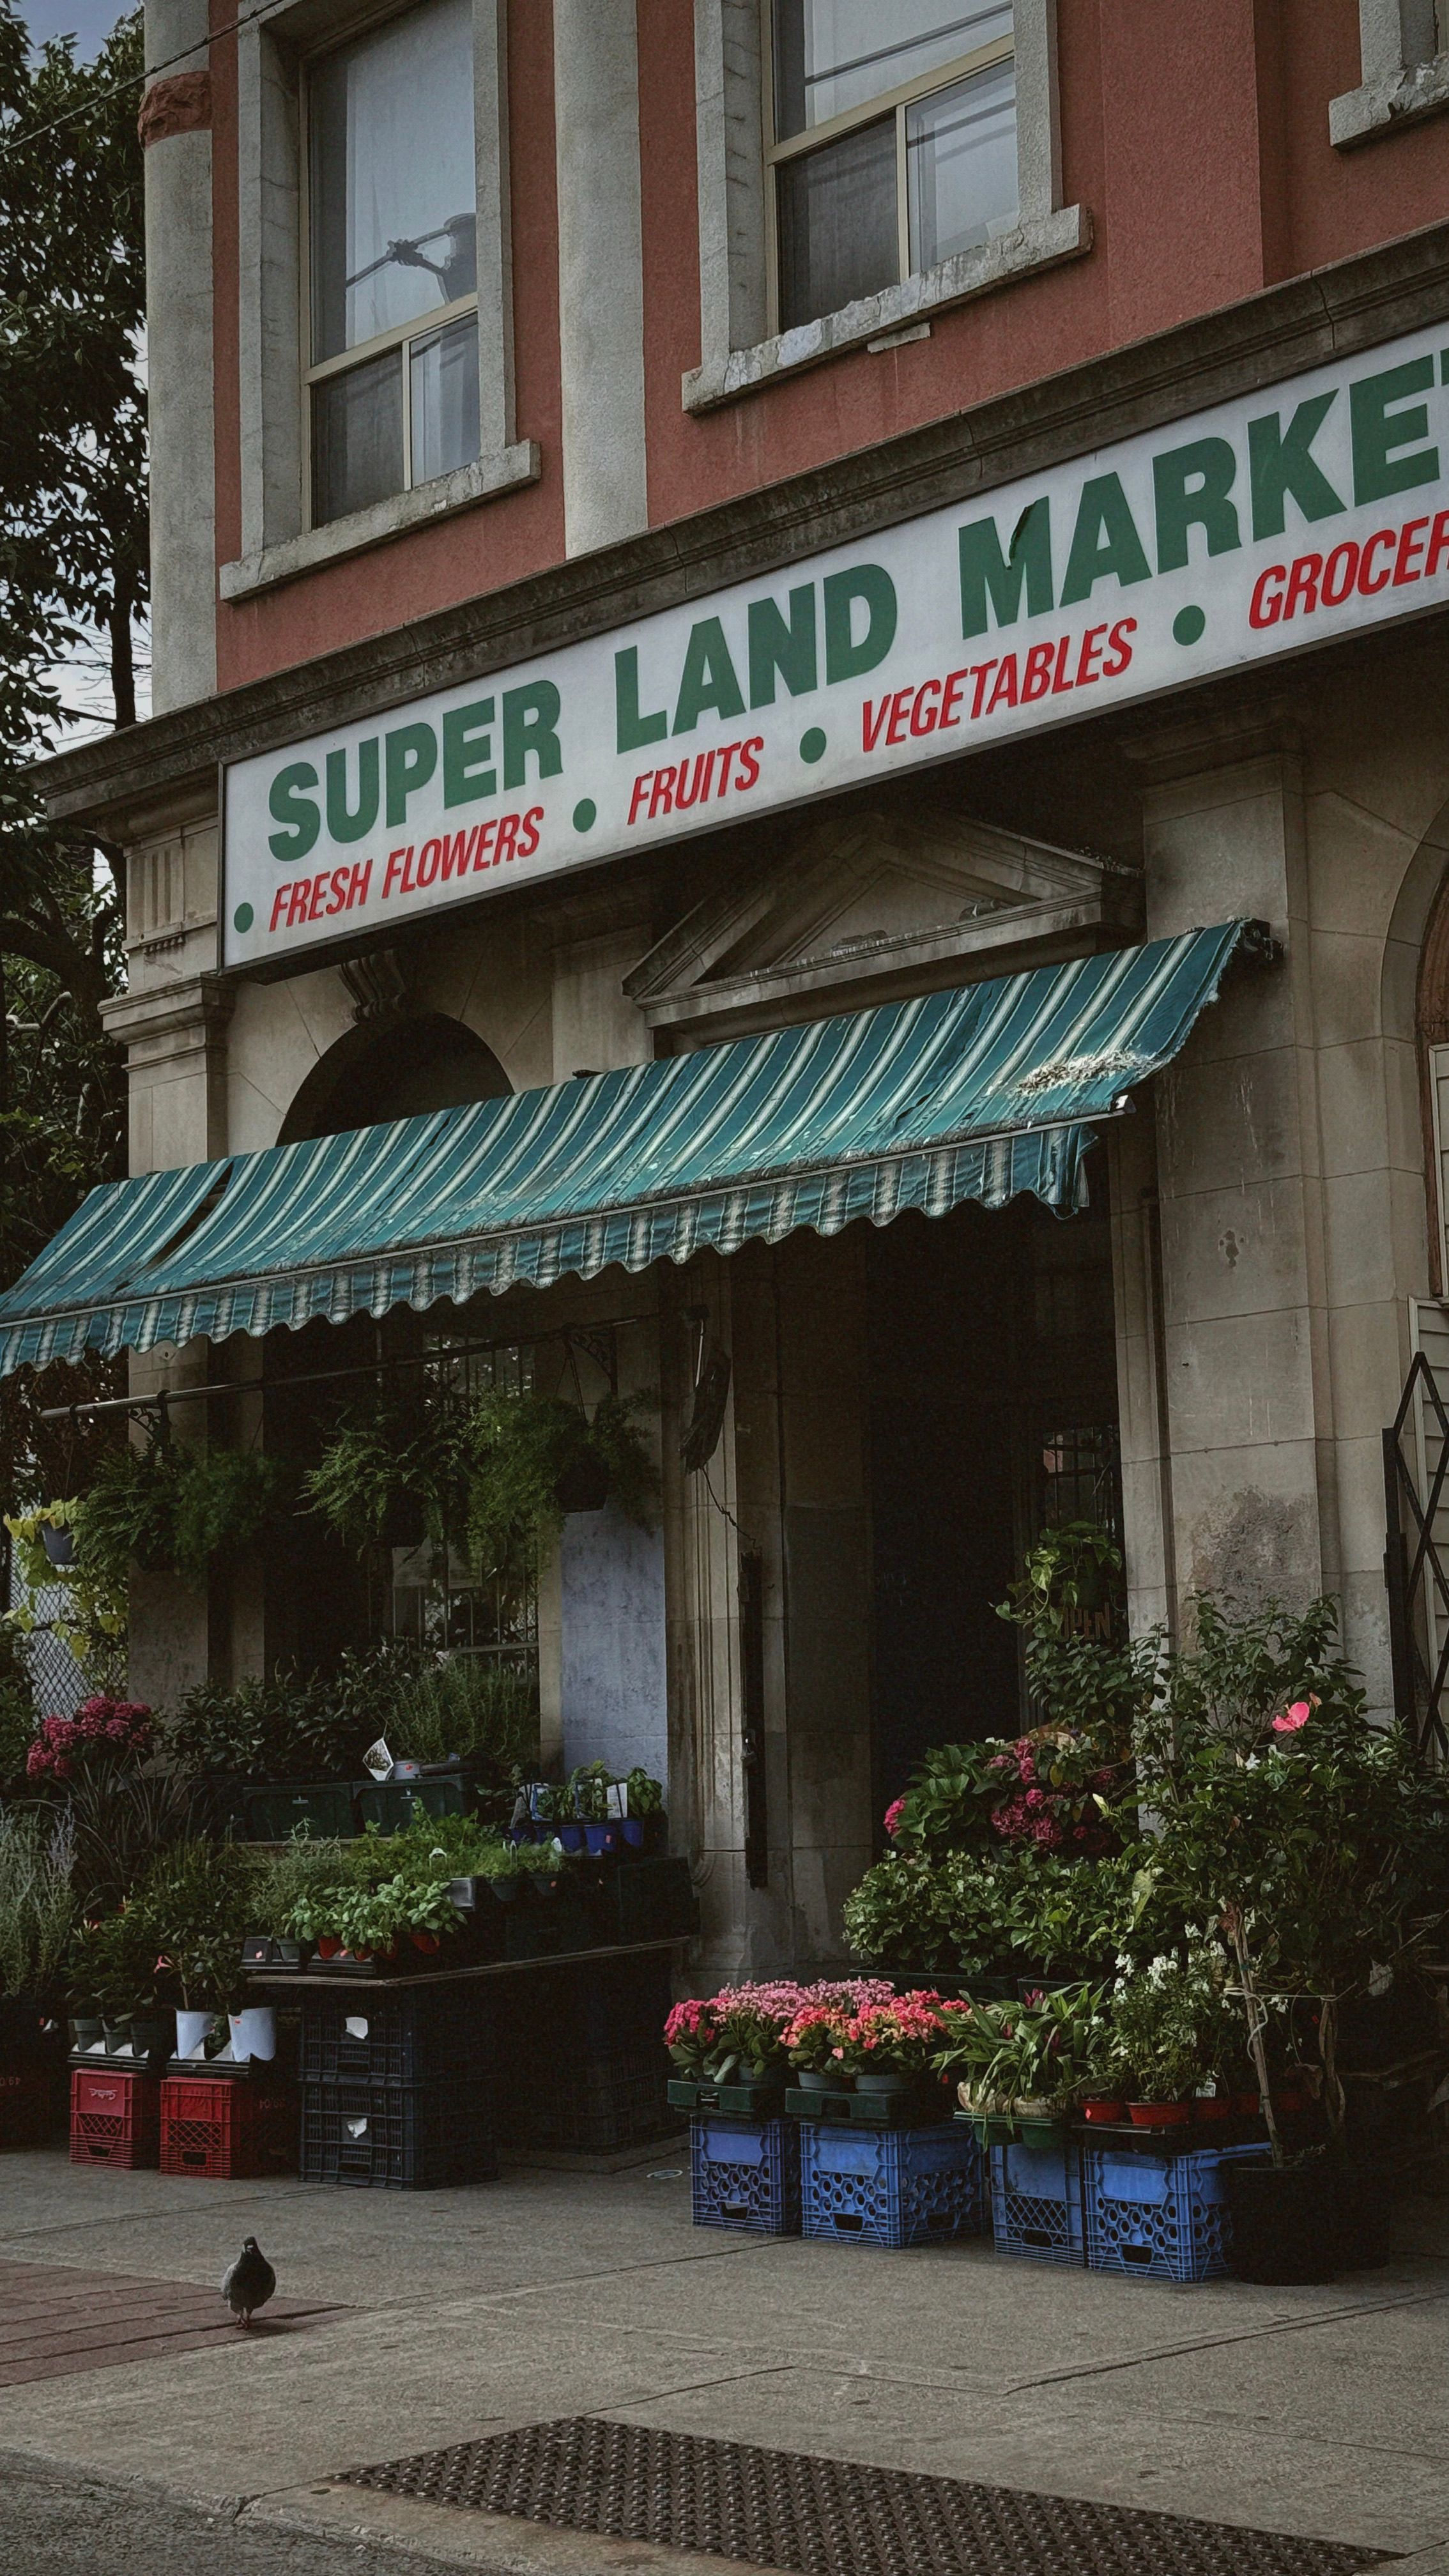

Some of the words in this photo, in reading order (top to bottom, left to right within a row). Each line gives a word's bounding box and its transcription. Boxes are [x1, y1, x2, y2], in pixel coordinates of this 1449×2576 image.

[268, 680, 564, 862] SUPER
[615, 564, 898, 753] LAND
[959, 348, 1449, 639] MARKE
[269, 860, 372, 931] FRESH
[381, 806, 544, 899] FLOWERS
[627, 735, 764, 825] FRUITS
[862, 617, 1138, 753] VEGETABLES
